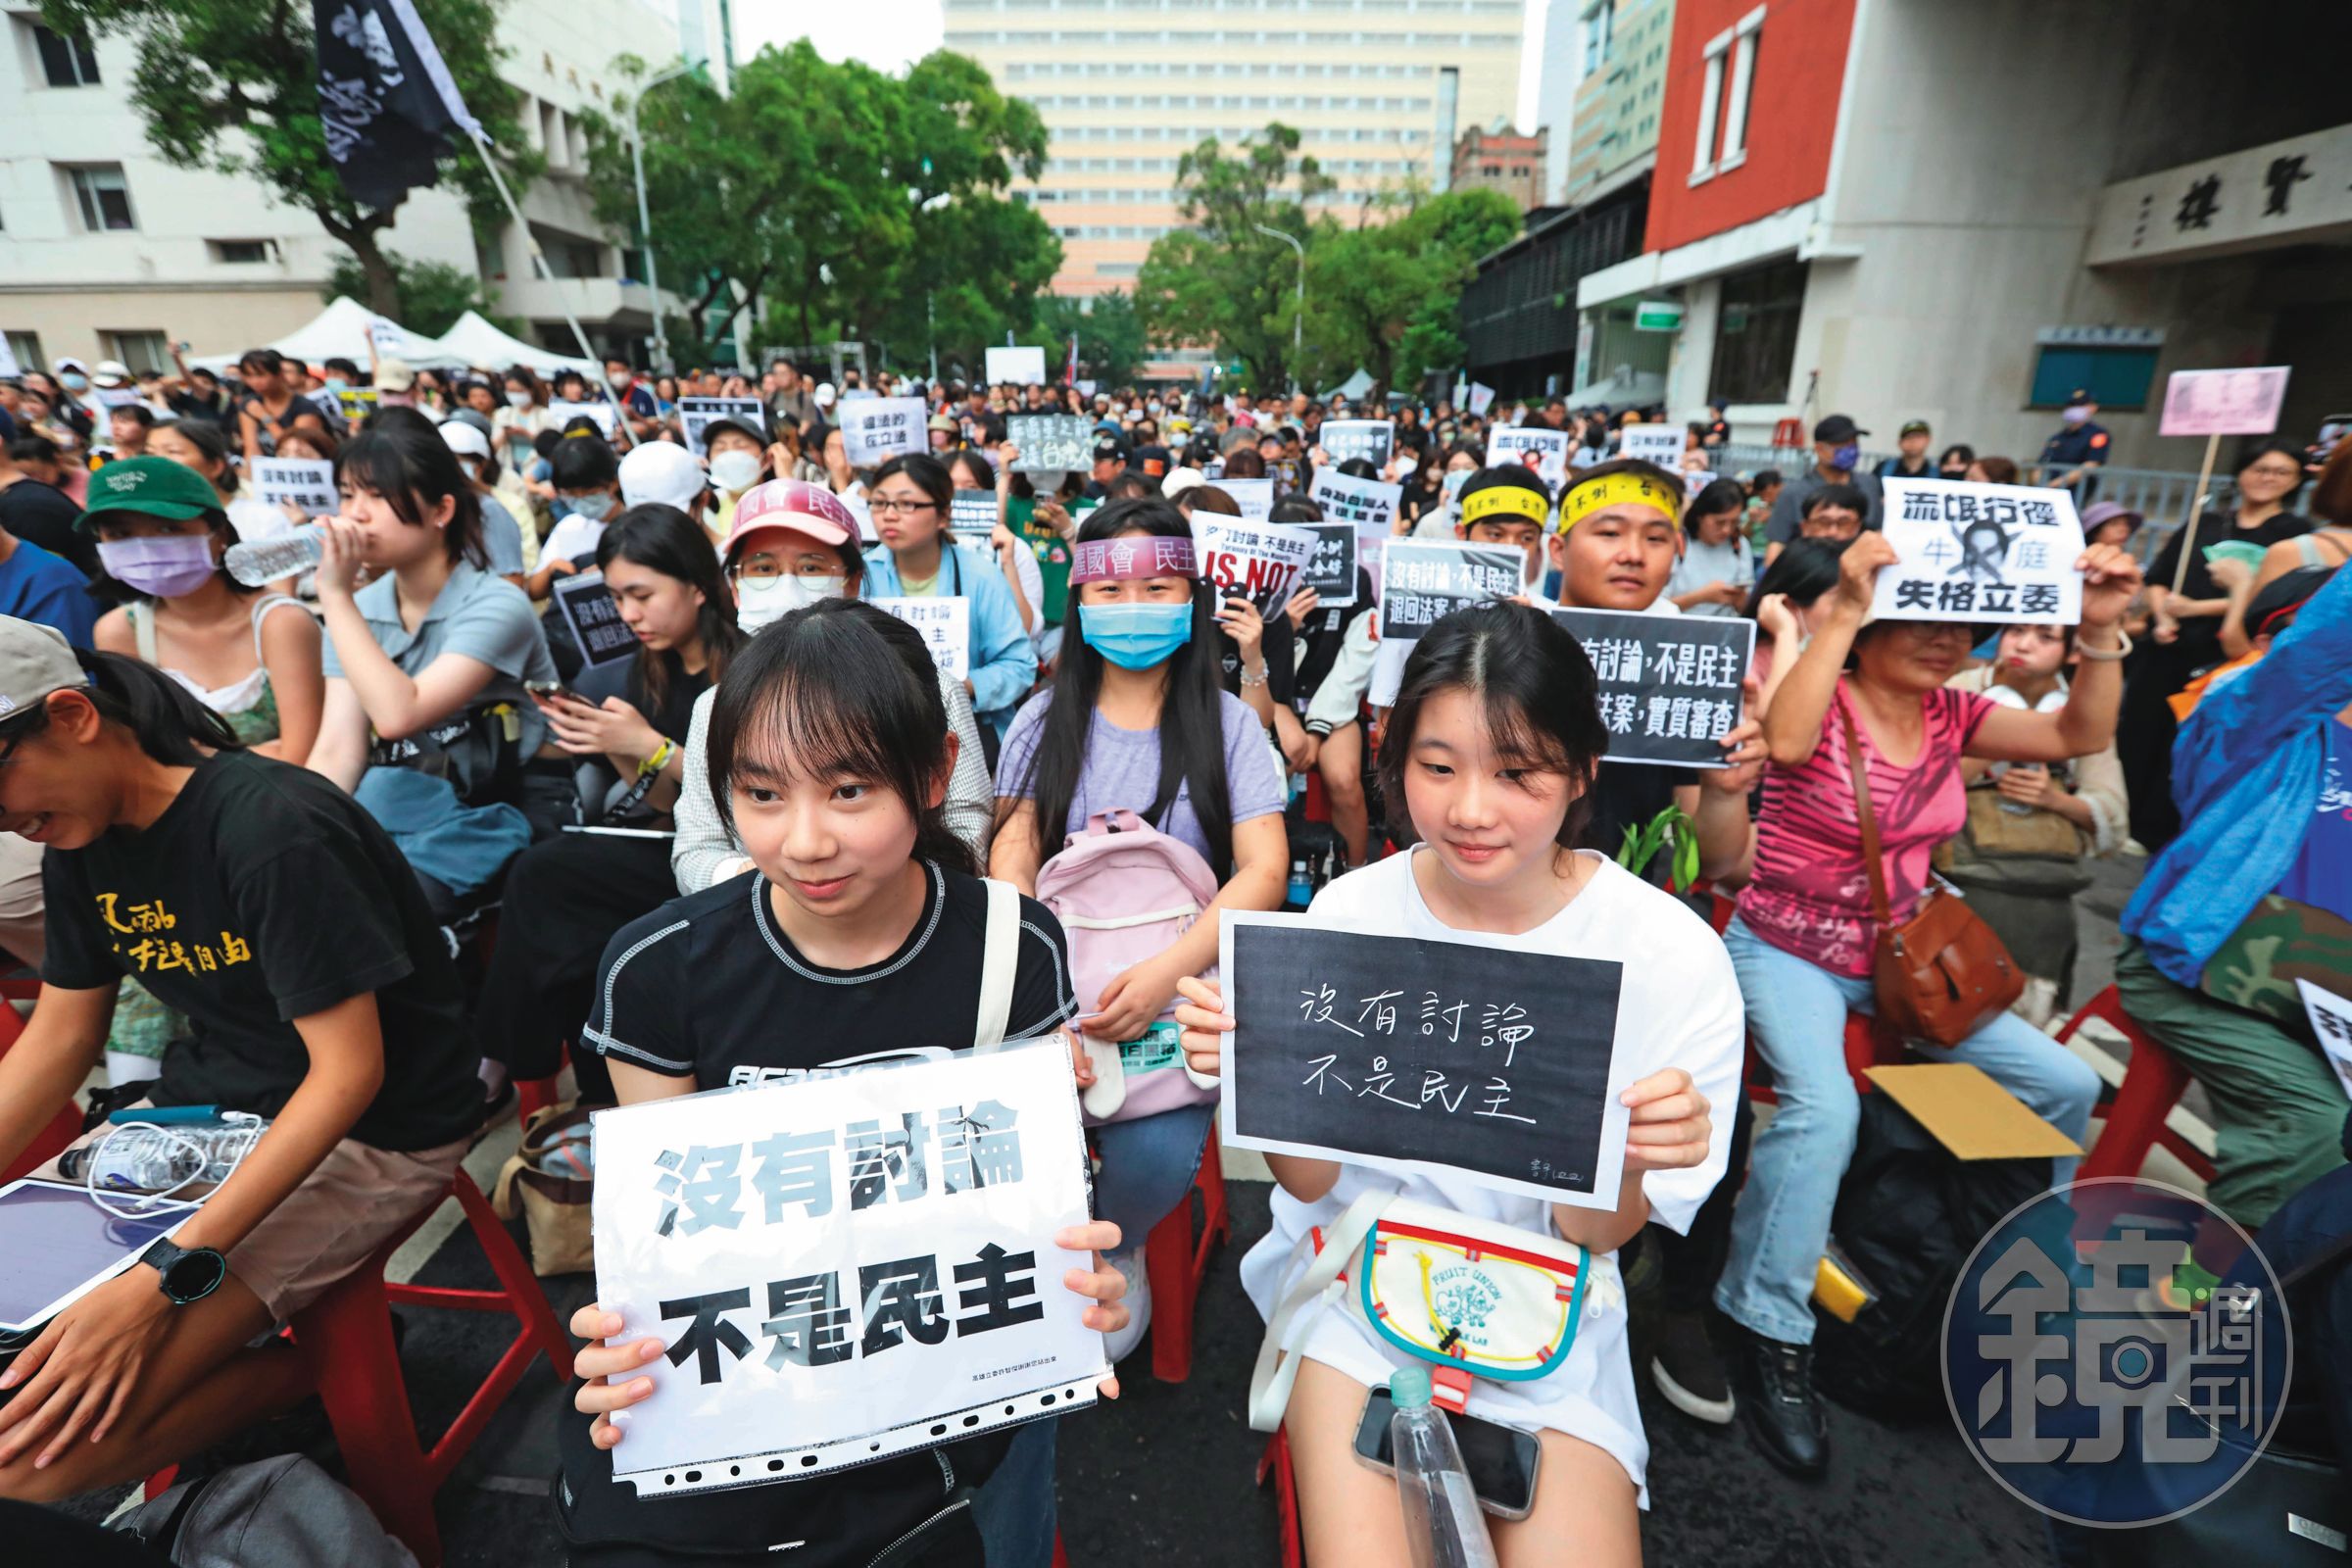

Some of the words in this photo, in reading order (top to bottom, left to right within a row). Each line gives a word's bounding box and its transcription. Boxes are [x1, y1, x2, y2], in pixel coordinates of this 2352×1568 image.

[1903, 491, 2061, 526] 流氓行徑
[1155, 540, 1195, 571] 民主
[1264, 534, 1305, 555] 不是民主
[1923, 536, 1954, 565] 牛
[2016, 540, 2048, 569] 庭
[1205, 551, 1238, 589] IS
[1246, 557, 1298, 593] NOT
[1896, 579, 2060, 613] 失格立委
[1300, 983, 1535, 1067] 沒有討論
[1302, 1054, 1537, 1124] 不是民主
[654, 1099, 1025, 1239] 沒有討論
[1432, 1267, 1468, 1285] FRUIT
[1472, 1269, 1502, 1299] UNION
[659, 1242, 1044, 1386] 不是民主
